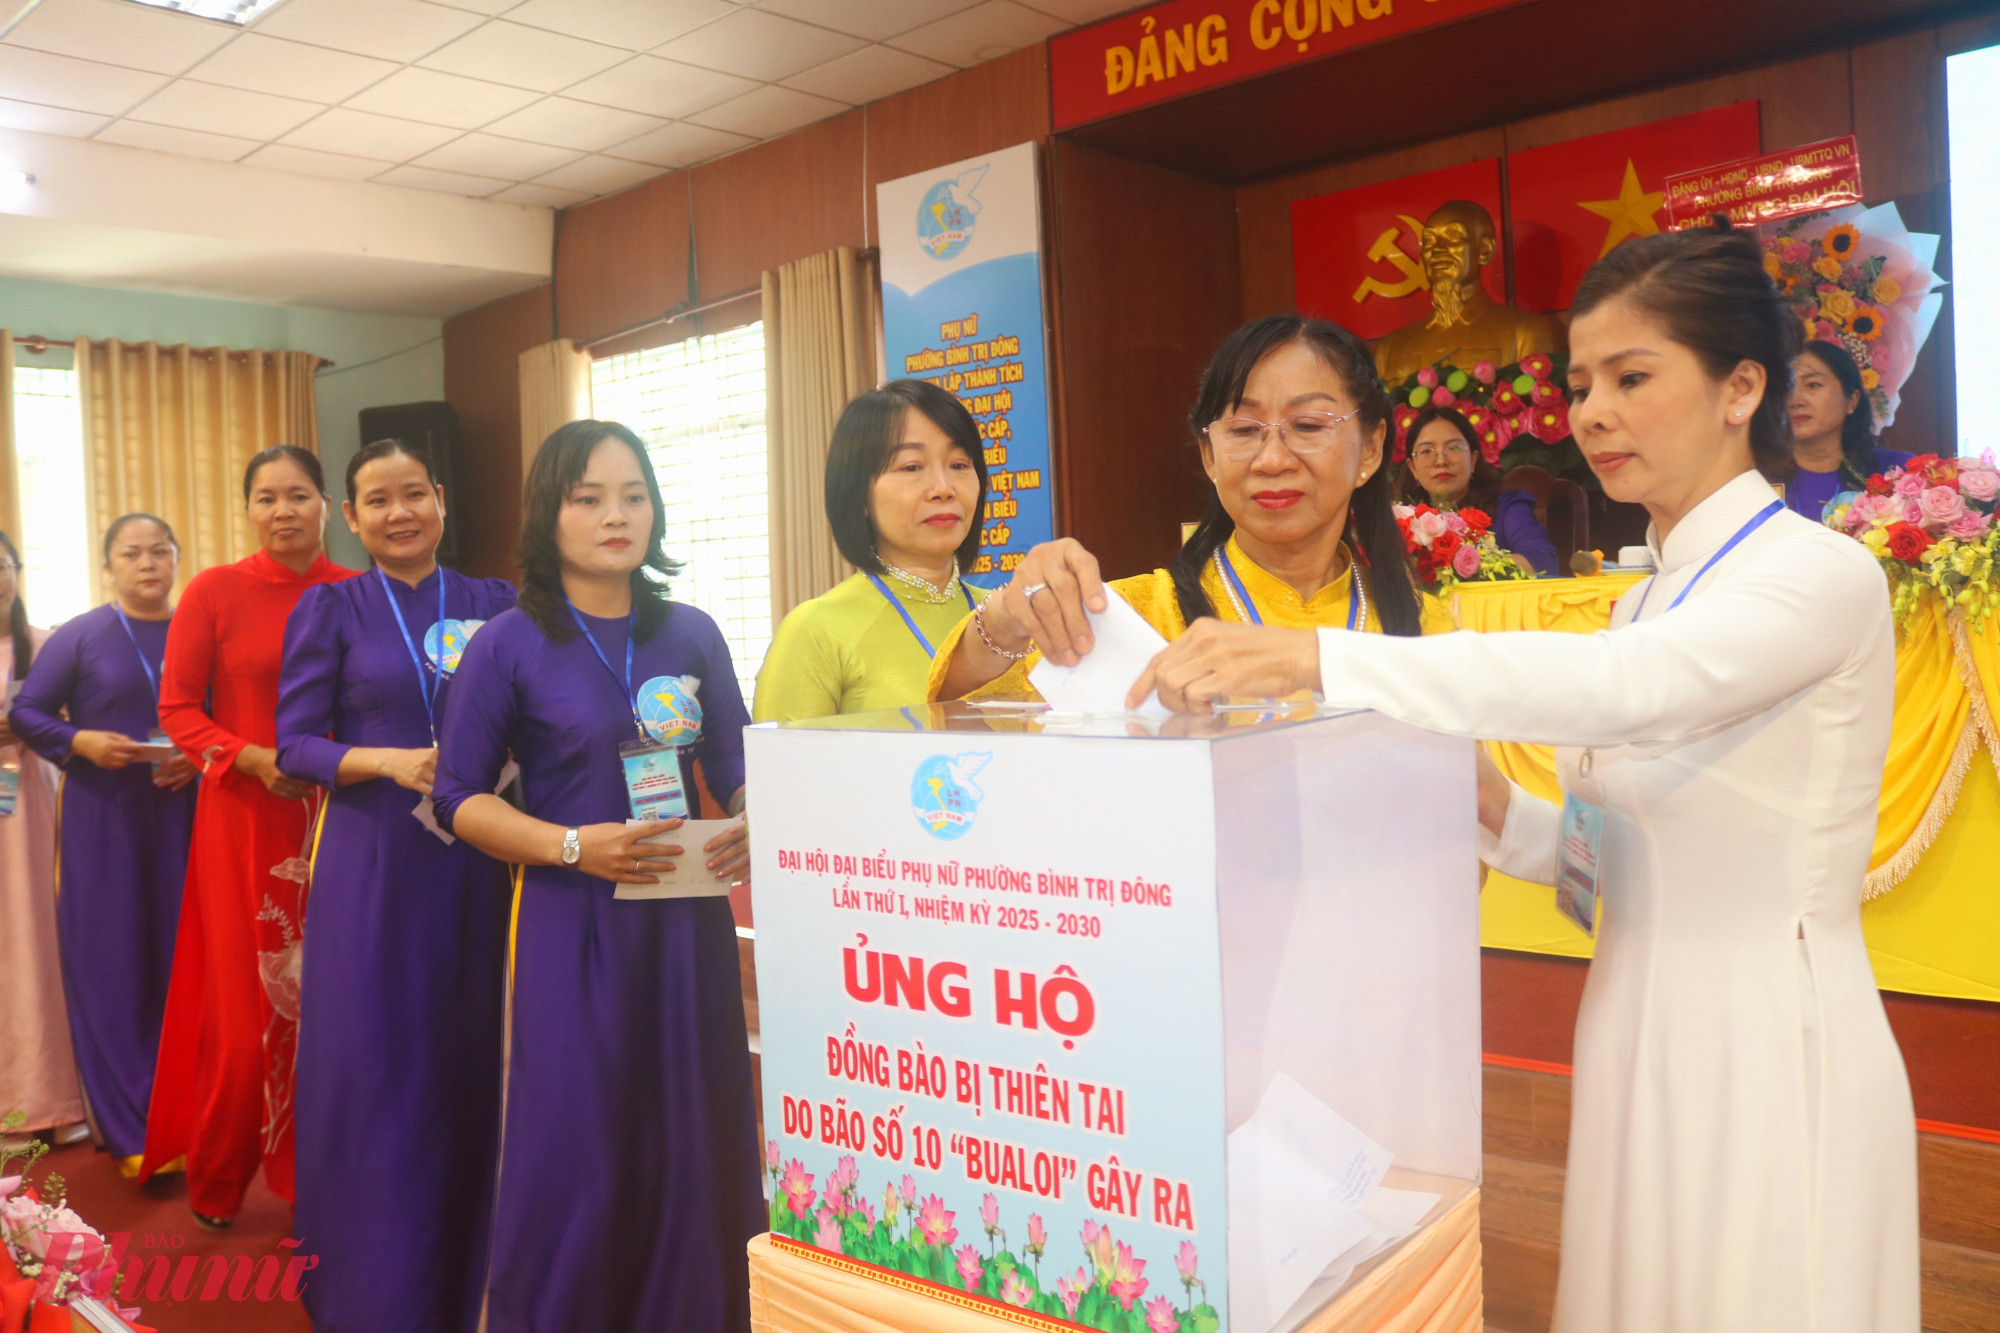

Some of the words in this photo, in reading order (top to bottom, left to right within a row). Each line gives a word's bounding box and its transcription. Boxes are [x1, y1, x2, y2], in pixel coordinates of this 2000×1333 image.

[1104, 15, 1229, 95] ĐẢNG
[1755, 160, 1784, 175] UBND
[1834, 143, 1850, 156] VN
[941, 320, 960, 342] PHỤ
[963, 313, 978, 337] NỮ
[905, 348, 945, 373] PHƯỜNG
[946, 343, 970, 366] BÌNH
[971, 341, 990, 364] TRỊ
[990, 334, 1019, 358] ĐÔNG
[943, 370, 962, 395] LẬP
[963, 365, 998, 390] THÀNH
[998, 360, 1024, 384] TÍCH
[974, 394, 992, 418] ĐẠI
[993, 387, 1012, 414] HỘI
[987, 413, 1012, 441] CẤP,
[990, 468, 1014, 493] VIỆT
[1016, 469, 1040, 490] NAM
[992, 491, 1017, 519] BIỂU
[989, 520, 1011, 547] CẤP
[778, 850, 801, 874] ĐẠI
[806, 848, 829, 877] HỘI
[833, 855, 857, 880] ĐẠI
[862, 848, 896, 880] BIỂU
[902, 861, 932, 888] PHỤ
[937, 860, 960, 887] NỮ
[965, 864, 1032, 894] PHƯỜNG
[1037, 868, 1079, 898] BÌNH
[1084, 877, 1114, 907] TRỊ
[1121, 876, 1172, 907] ĐÔNG
[833, 878, 861, 910] LẦN
[864, 888, 895, 914] THỨ
[914, 895, 965, 925] NHIỆM
[970, 899, 991, 926] KỲ
[997, 906, 1039, 931] 2025
[1056, 913, 1101, 938] 2030
[842, 932, 972, 1018] ỦNG
[994, 964, 1095, 1050] HỘ
[827, 1022, 890, 1088] ĐỒNG
[897, 1041, 947, 1099] BÀO
[955, 1060, 981, 1116] BỊ
[988, 1063, 1070, 1124] THIÊN
[1078, 1083, 1124, 1135] TAI
[783, 1095, 813, 1139] DO
[820, 1097, 865, 1152] BÃO
[872, 1105, 904, 1161] SỐ
[912, 1125, 942, 1170] 10
[950, 1133, 1076, 1199] “BUALOI”
[1087, 1155, 1143, 1217] GÂY
[1154, 1177, 1194, 1231] RA
